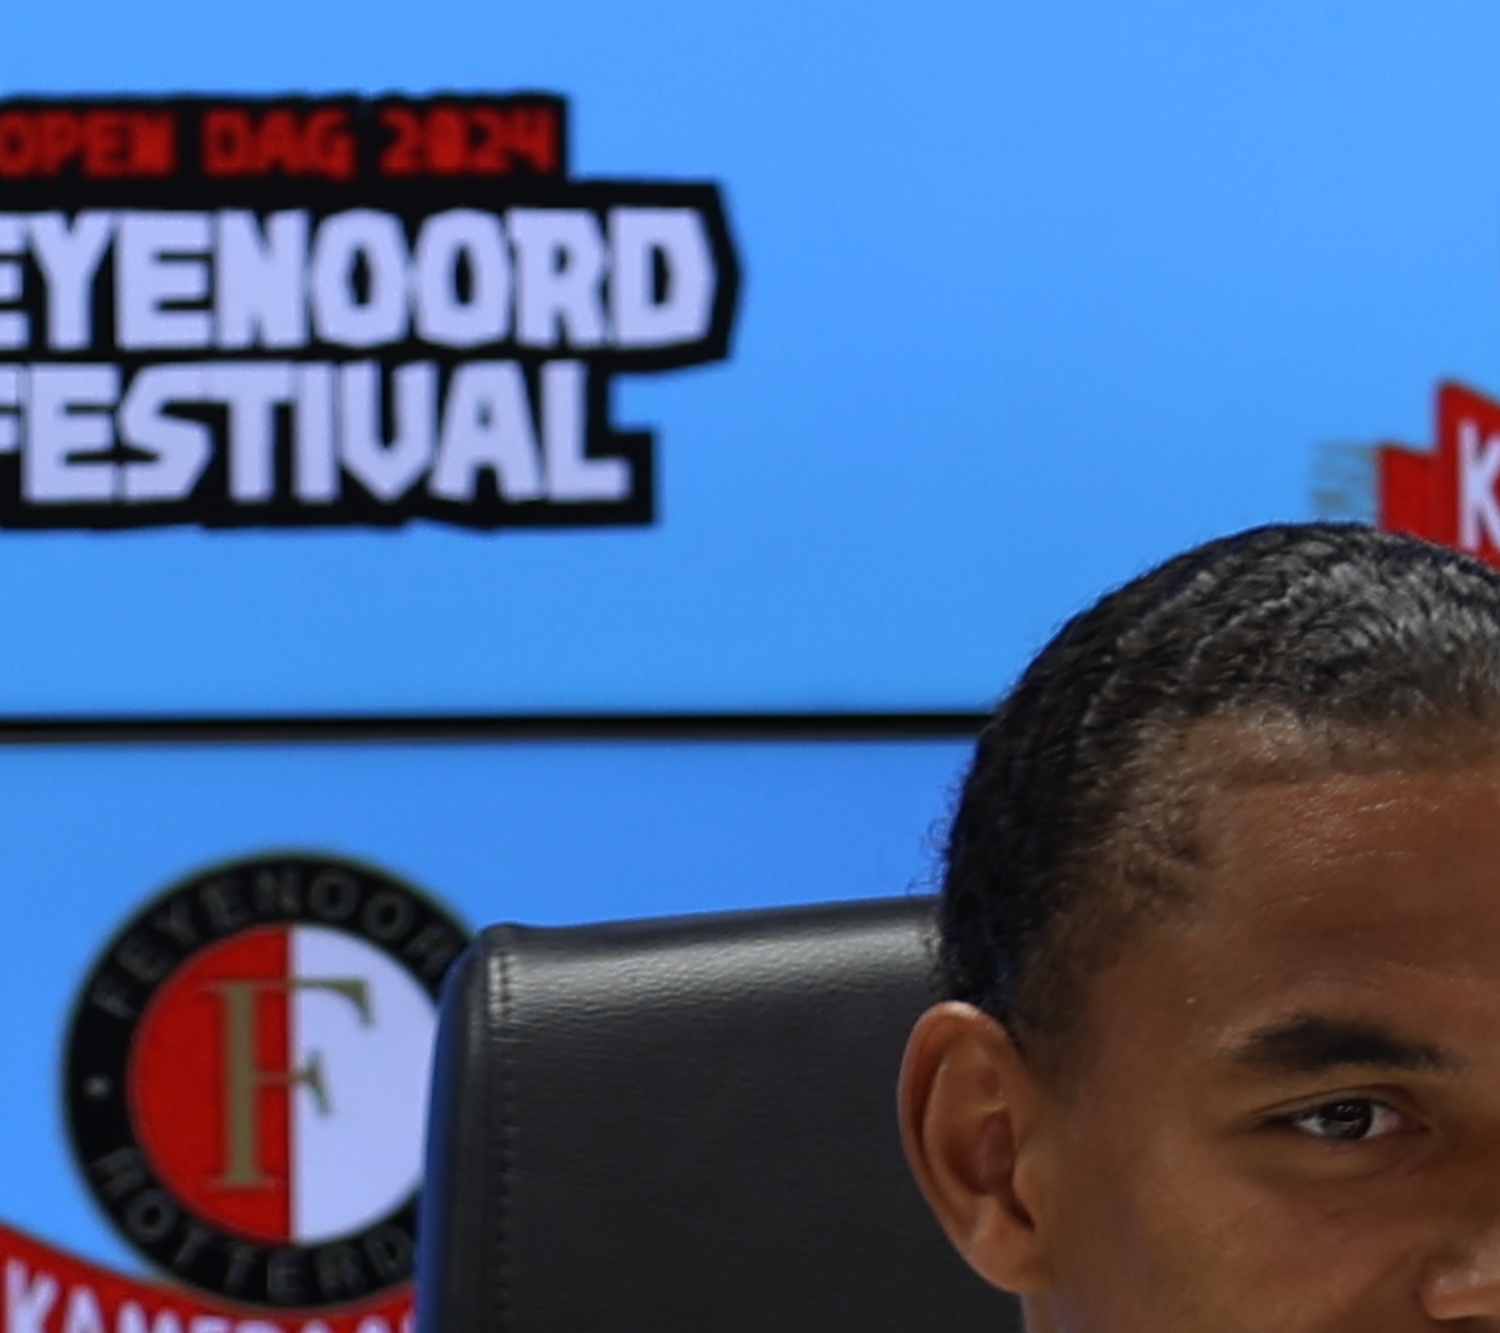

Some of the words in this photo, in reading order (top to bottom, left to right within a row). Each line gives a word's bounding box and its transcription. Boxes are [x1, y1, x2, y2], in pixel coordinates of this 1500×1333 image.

[203, 109, 354, 183] DAG
[379, 105, 557, 178] 2024
[90, 862, 462, 1020] FEYENOOR
